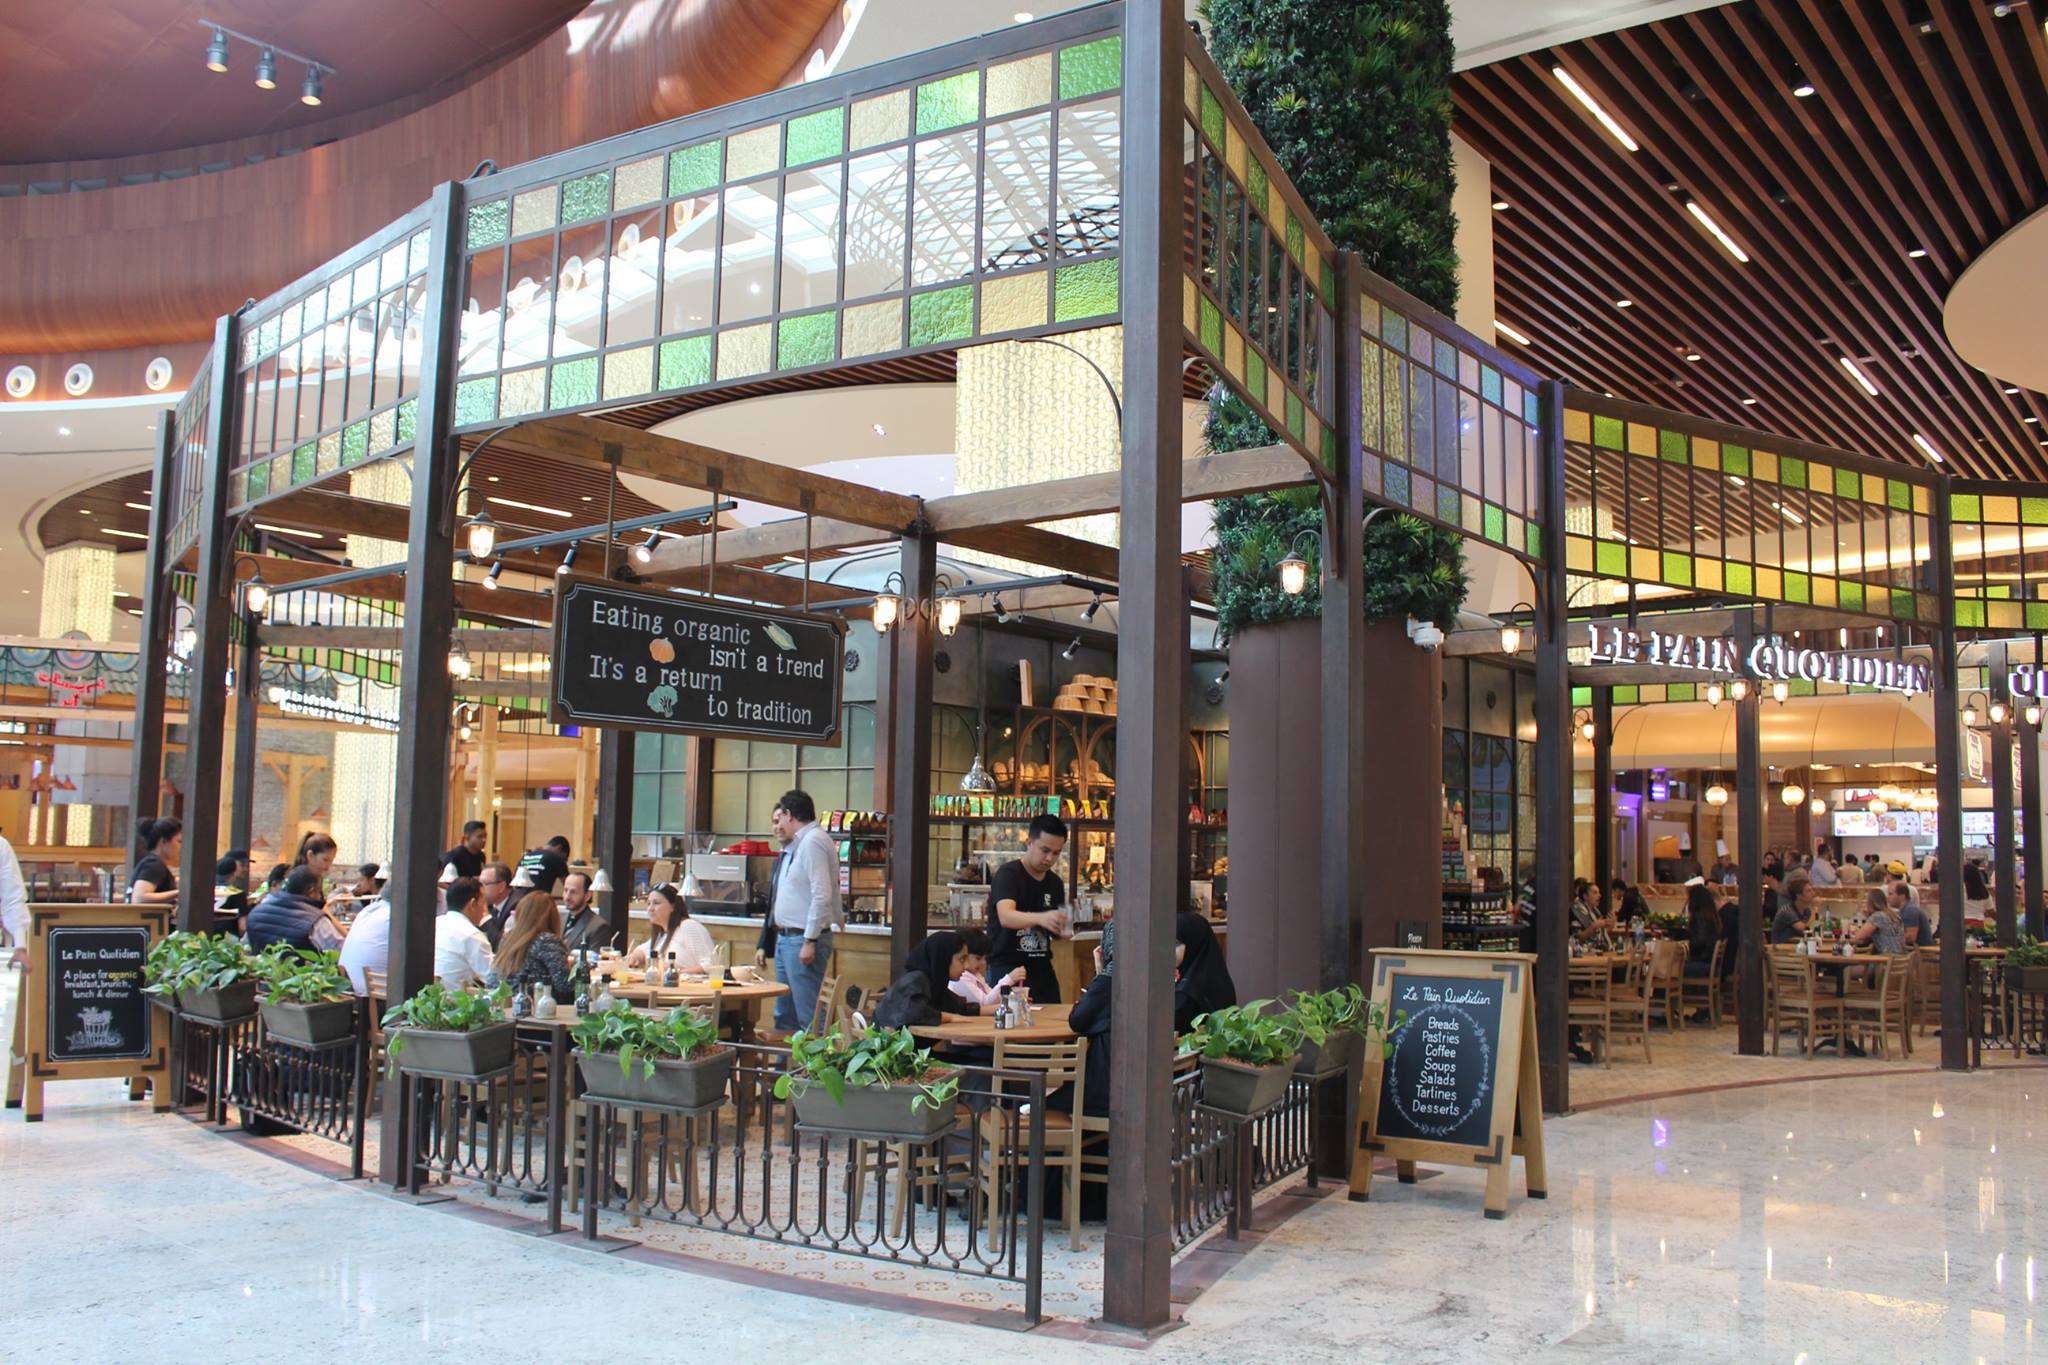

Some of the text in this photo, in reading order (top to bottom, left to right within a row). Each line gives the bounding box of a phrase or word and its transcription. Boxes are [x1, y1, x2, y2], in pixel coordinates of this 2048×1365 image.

[592, 600, 751, 645] Eating organic
[709, 645, 825, 679] isn't a trend
[1588, 624, 1930, 693] LE PAIN QUOTIDIEN
[589, 654, 723, 692] It's a return
[707, 694, 812, 725] to tradition
[62, 948, 140, 960] Le Pain Quotidien
[63, 970, 72, 979] A
[73, 970, 97, 981] place
[72, 990, 94, 999] lunch
[105, 989, 129, 999] dinner
[1402, 986, 1490, 1005] Le Pain Quotidien
[1428, 1016, 1459, 1030] Breads
[1422, 1030, 1460, 1044] Pastries
[1425, 1044, 1456, 1058] Coffee
[1424, 1057, 1456, 1073] Soups
[1419, 1070, 1455, 1086] Salads
[1416, 1084, 1457, 1101] Tartines
[1412, 1099, 1460, 1116] Desserts
